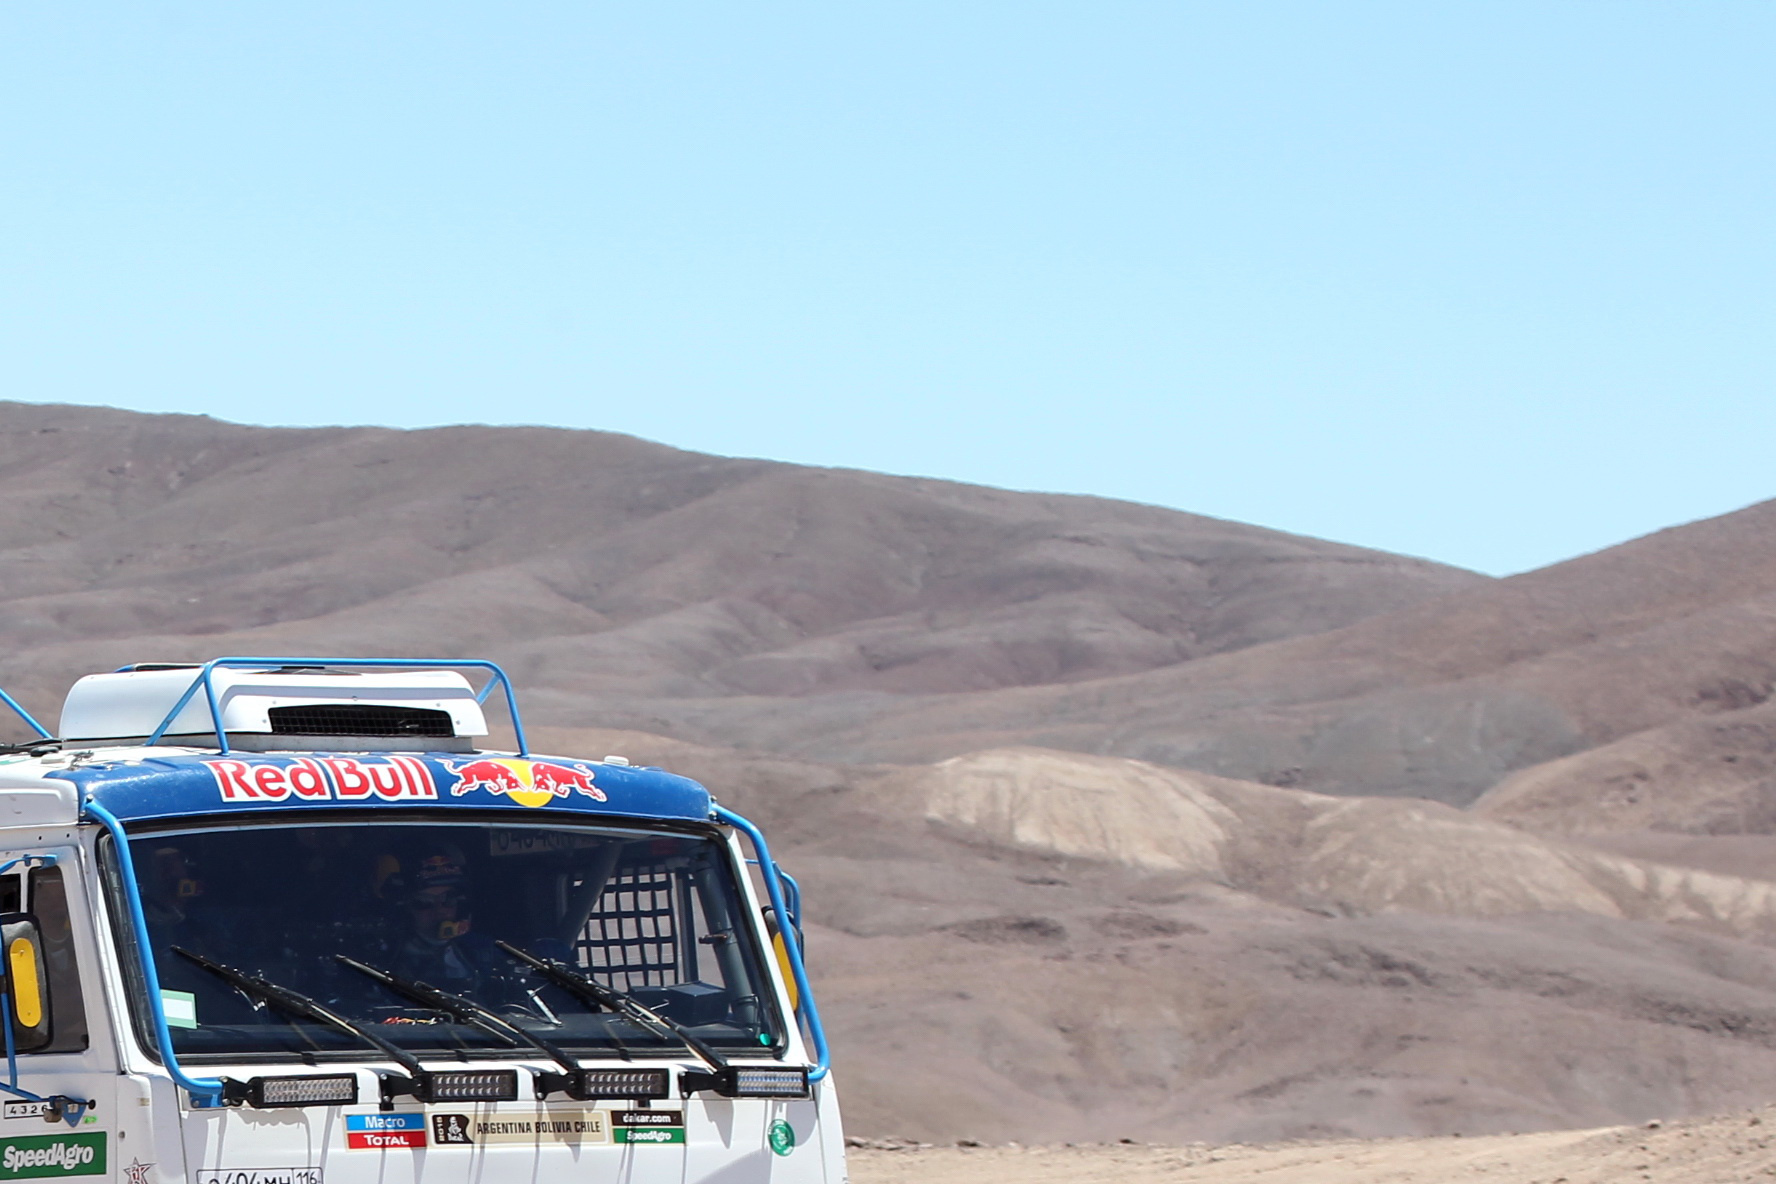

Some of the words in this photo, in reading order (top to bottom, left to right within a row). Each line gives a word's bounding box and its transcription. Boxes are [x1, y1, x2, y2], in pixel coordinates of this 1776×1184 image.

[204, 757, 328, 801] Red
[324, 756, 437, 800] Bull
[365, 1114, 406, 1129] Macro
[477, 1121, 532, 1134] ARGENTINA
[535, 1121, 572, 1134] BOLIVIA
[574, 1120, 601, 1133] CHILE
[363, 1134, 410, 1147] TOTAL
[627, 1130, 672, 1142] SpeedAgro
[2, 1143, 94, 1172] SpeedAgro
